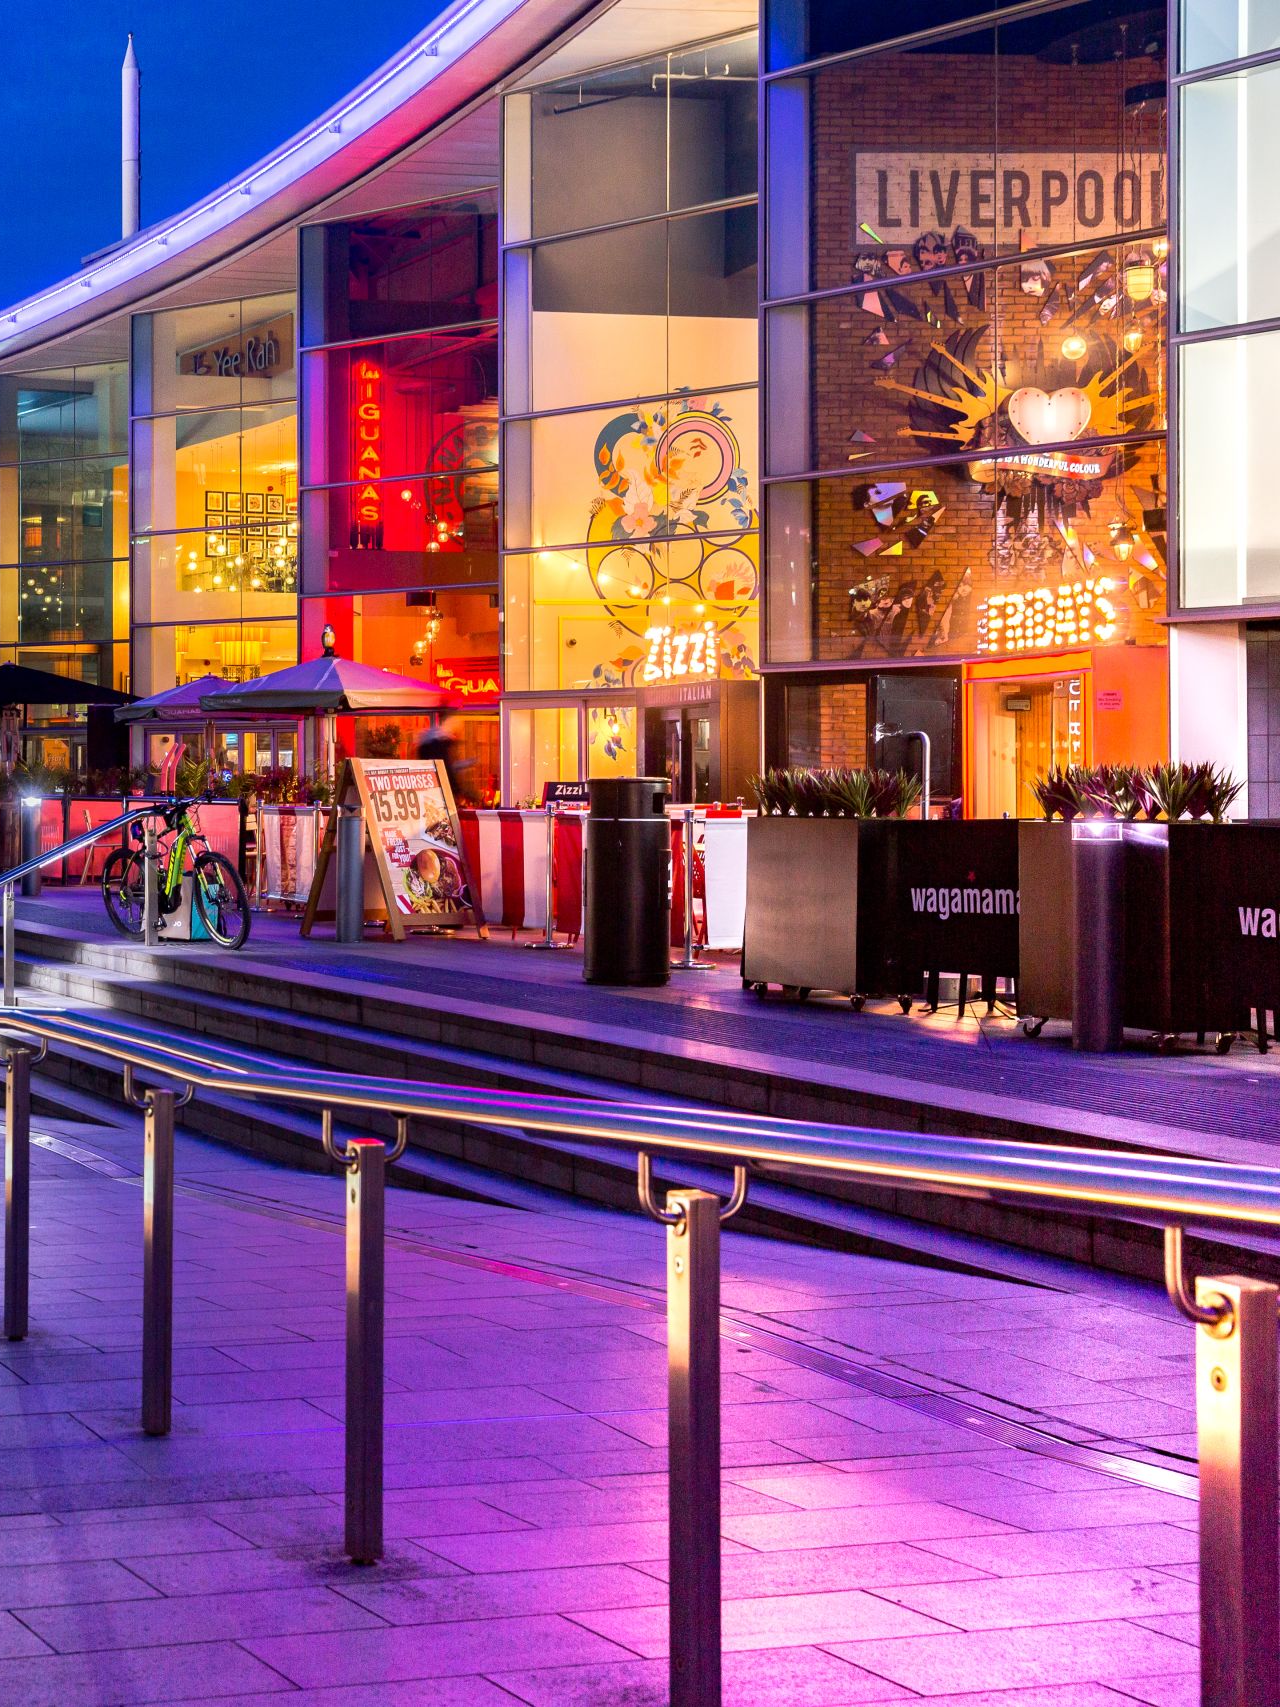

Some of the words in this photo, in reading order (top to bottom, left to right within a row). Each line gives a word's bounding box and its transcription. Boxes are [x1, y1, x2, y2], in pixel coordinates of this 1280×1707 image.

[876, 169, 1167, 228] LIVERPOOL
[213, 348, 241, 377] Yee
[246, 334, 277, 374] Rah
[358, 383, 381, 522] IGUANAS
[1069, 462, 1101, 474] COLOUR
[642, 621, 718, 682] Zizzi
[439, 677, 499, 696] IGUA
[679, 685, 712, 702] ITALIAN
[369, 775, 391, 791] TWO
[392, 773, 435, 790] COURSES
[555, 784, 583, 796] Zizzi
[370, 788, 421, 822] 15.99
[1238, 906, 1280, 938] wa
